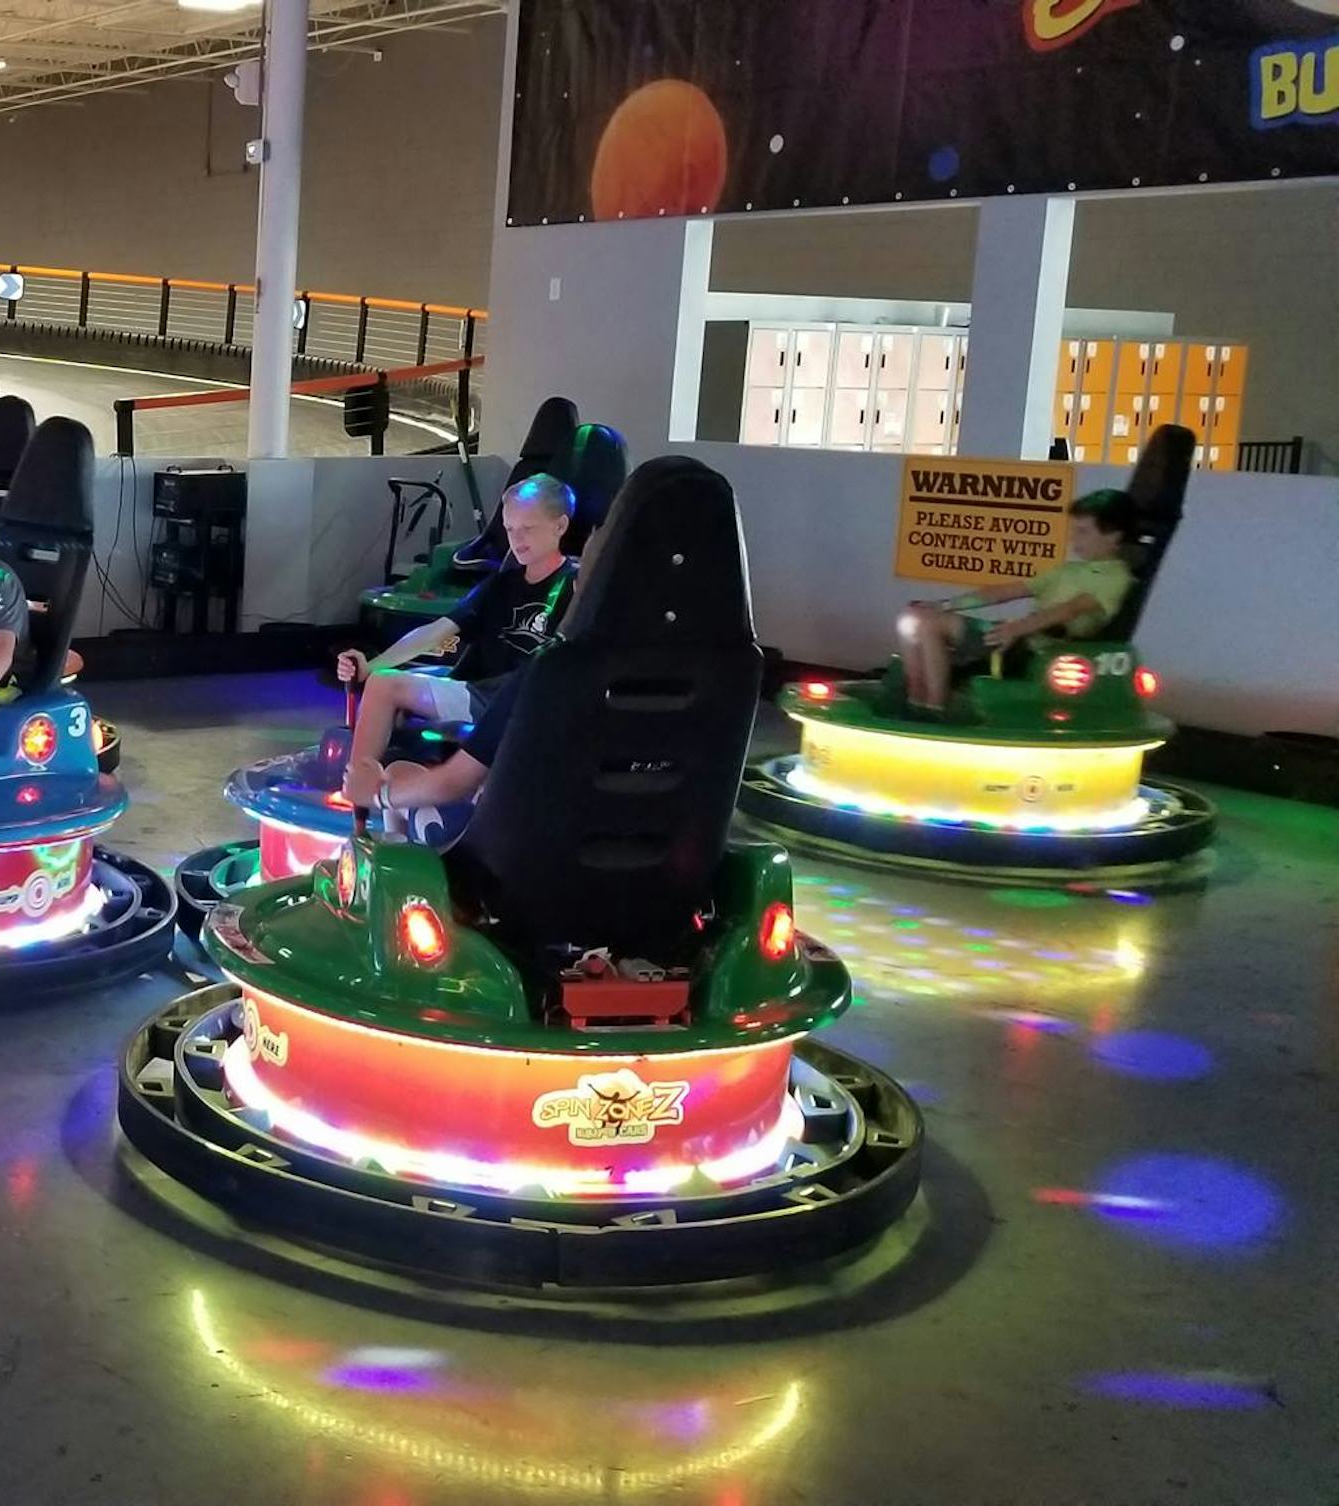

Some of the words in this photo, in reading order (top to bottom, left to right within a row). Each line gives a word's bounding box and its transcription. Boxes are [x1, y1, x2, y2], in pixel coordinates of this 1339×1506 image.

[911, 470, 1063, 501] WARNING
[915, 511, 985, 531] PLEASE
[989, 516, 1051, 536] AVOID
[908, 531, 996, 552] CONTACT
[1001, 538, 1056, 559] WITH
[921, 552, 984, 572] GUARD
[989, 559, 1037, 577] RAIL
[1095, 652, 1131, 676] 10
[68, 706, 87, 737] 3
[540, 1098, 592, 1121] SPIN
